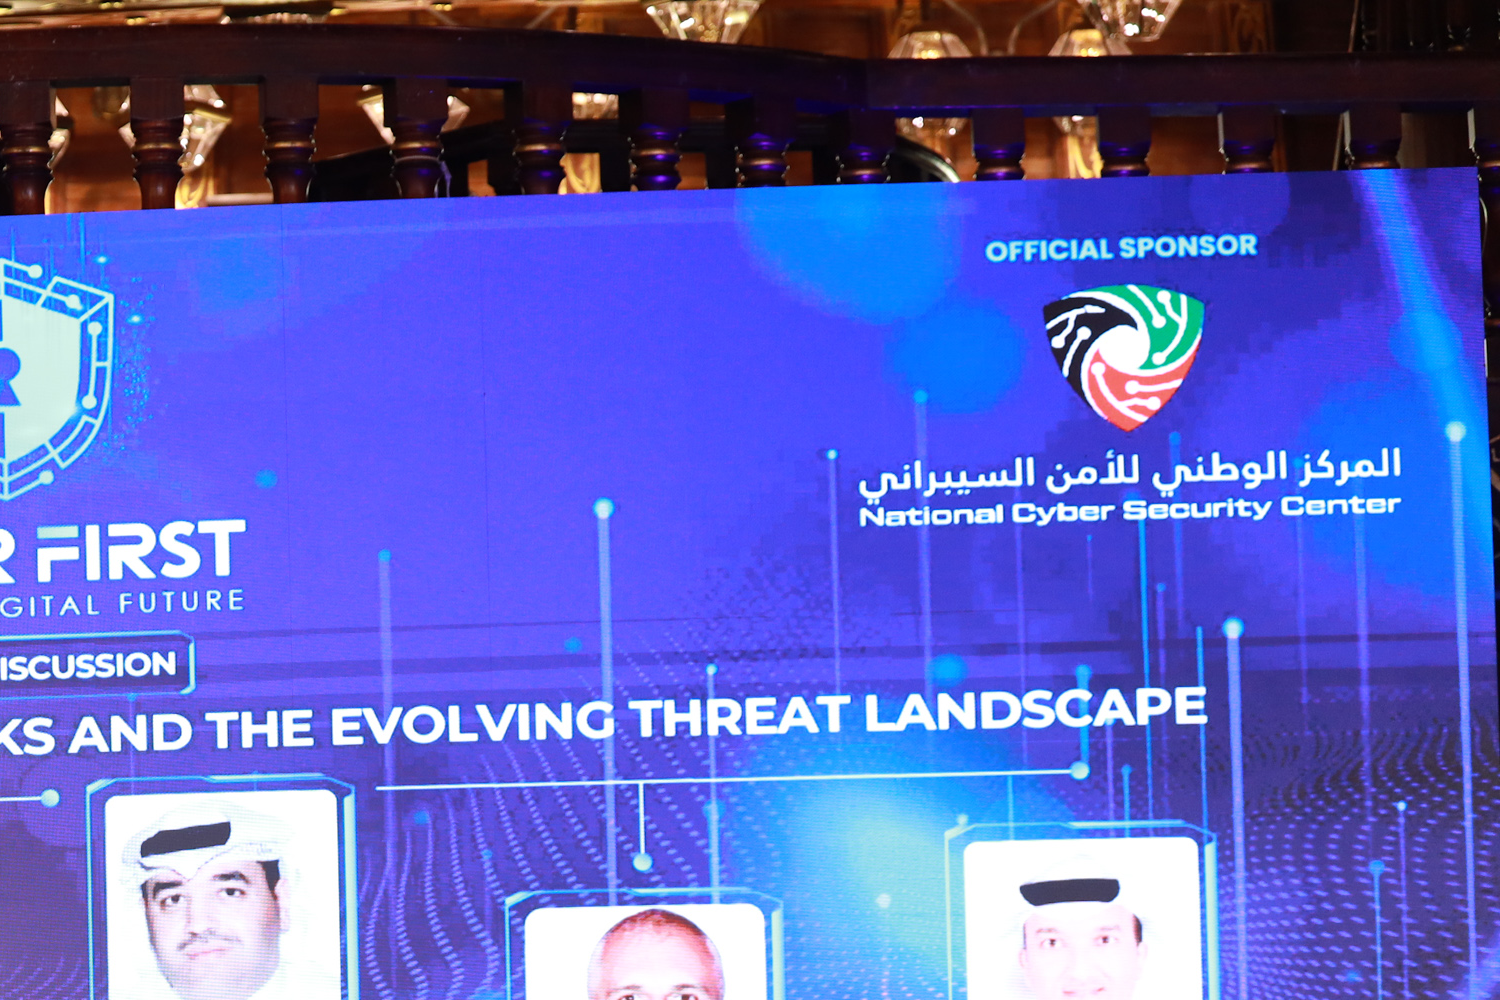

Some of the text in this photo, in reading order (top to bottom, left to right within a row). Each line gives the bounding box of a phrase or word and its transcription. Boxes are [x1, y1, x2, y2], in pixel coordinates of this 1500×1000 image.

[986, 233, 1257, 263] OFFICIAL SPONSOR
[858, 447, 1401, 505] المركز الوطني للأمن السيبراني
[859, 495, 1402, 527] National Cyber Security Center
[36, 519, 246, 582] FIRST
[119, 589, 245, 614] FUTURE
[67, 712, 193, 754] AND
[209, 709, 314, 749] THE
[331, 699, 615, 746] EVOLVING
[628, 693, 842, 737] THREAT
[865, 686, 1209, 733] LANDSCAPE
